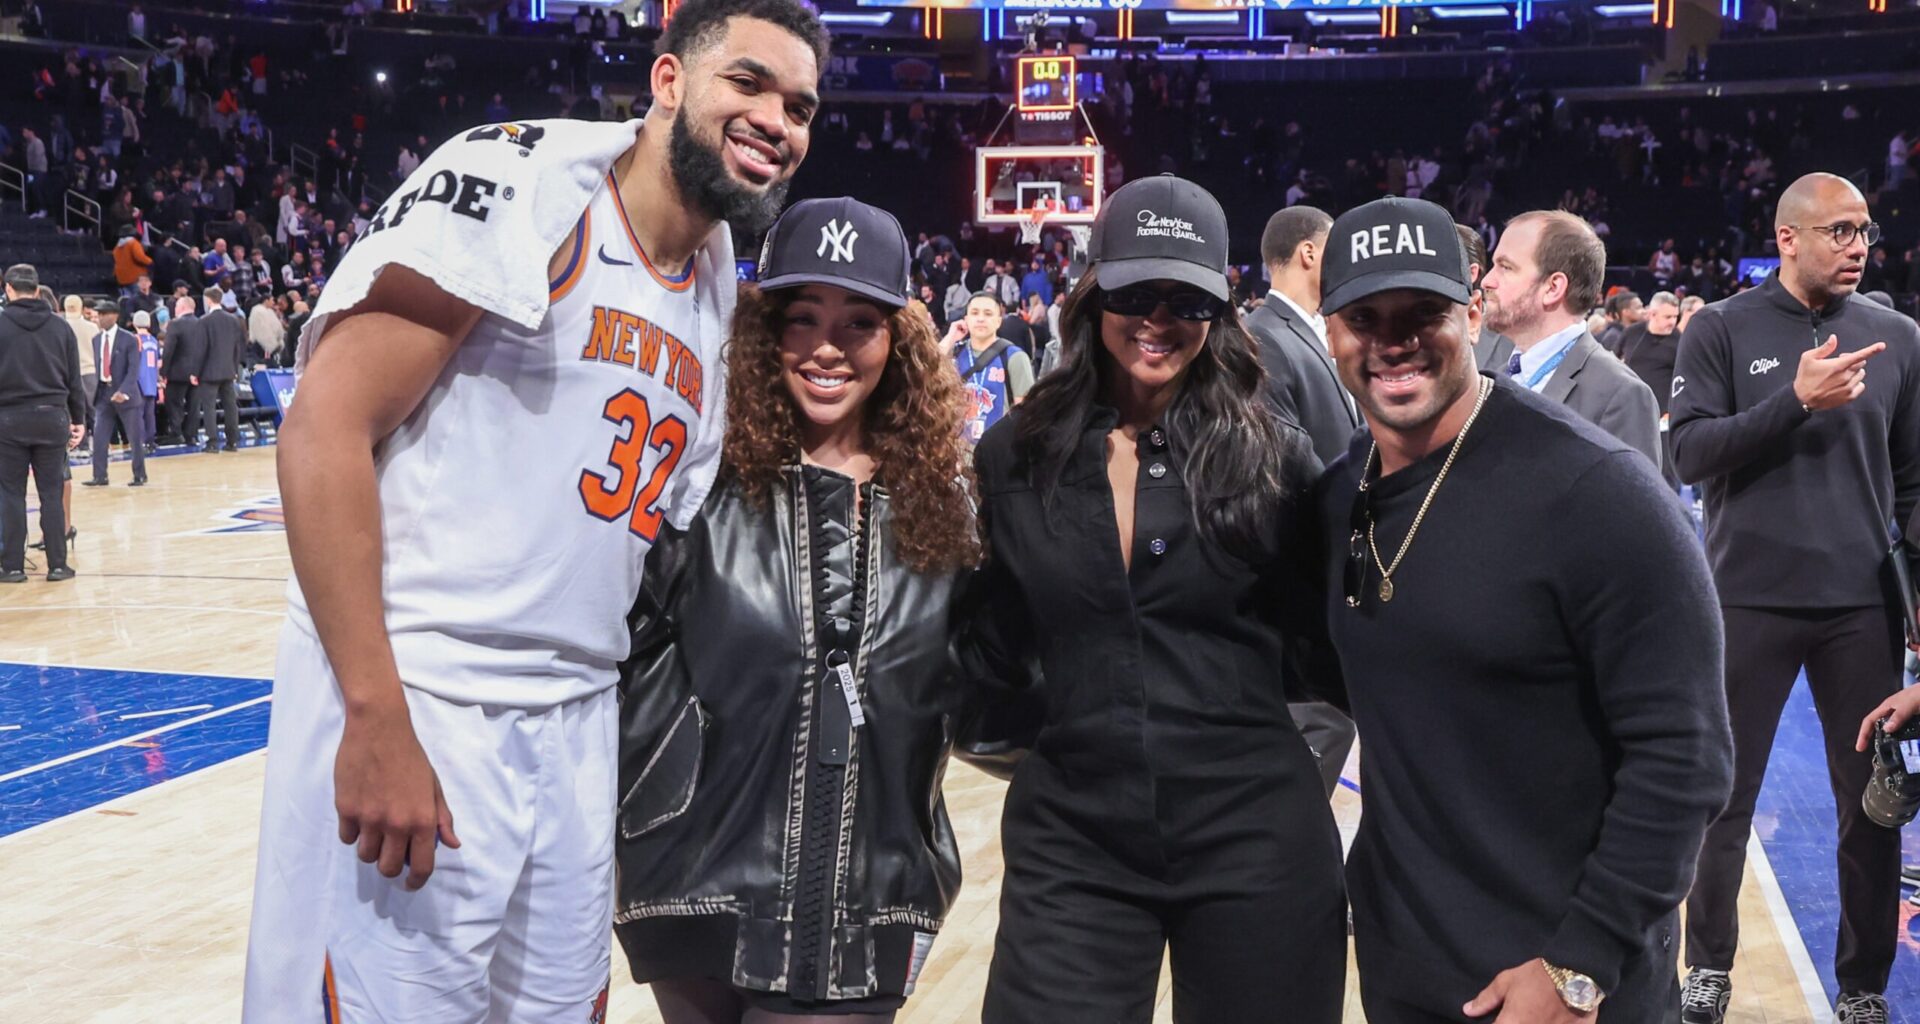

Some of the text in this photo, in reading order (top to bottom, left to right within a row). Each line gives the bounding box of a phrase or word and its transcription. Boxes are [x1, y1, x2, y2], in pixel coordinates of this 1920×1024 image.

[1034, 111, 1072, 121] TISSOT
[816, 218, 859, 263] NY
[1351, 223, 1437, 264] REAL
[579, 304, 703, 418] NEW YOR
[1749, 357, 1780, 375] Clips
[578, 386, 688, 546] 32
[840, 668, 855, 692] 2025
